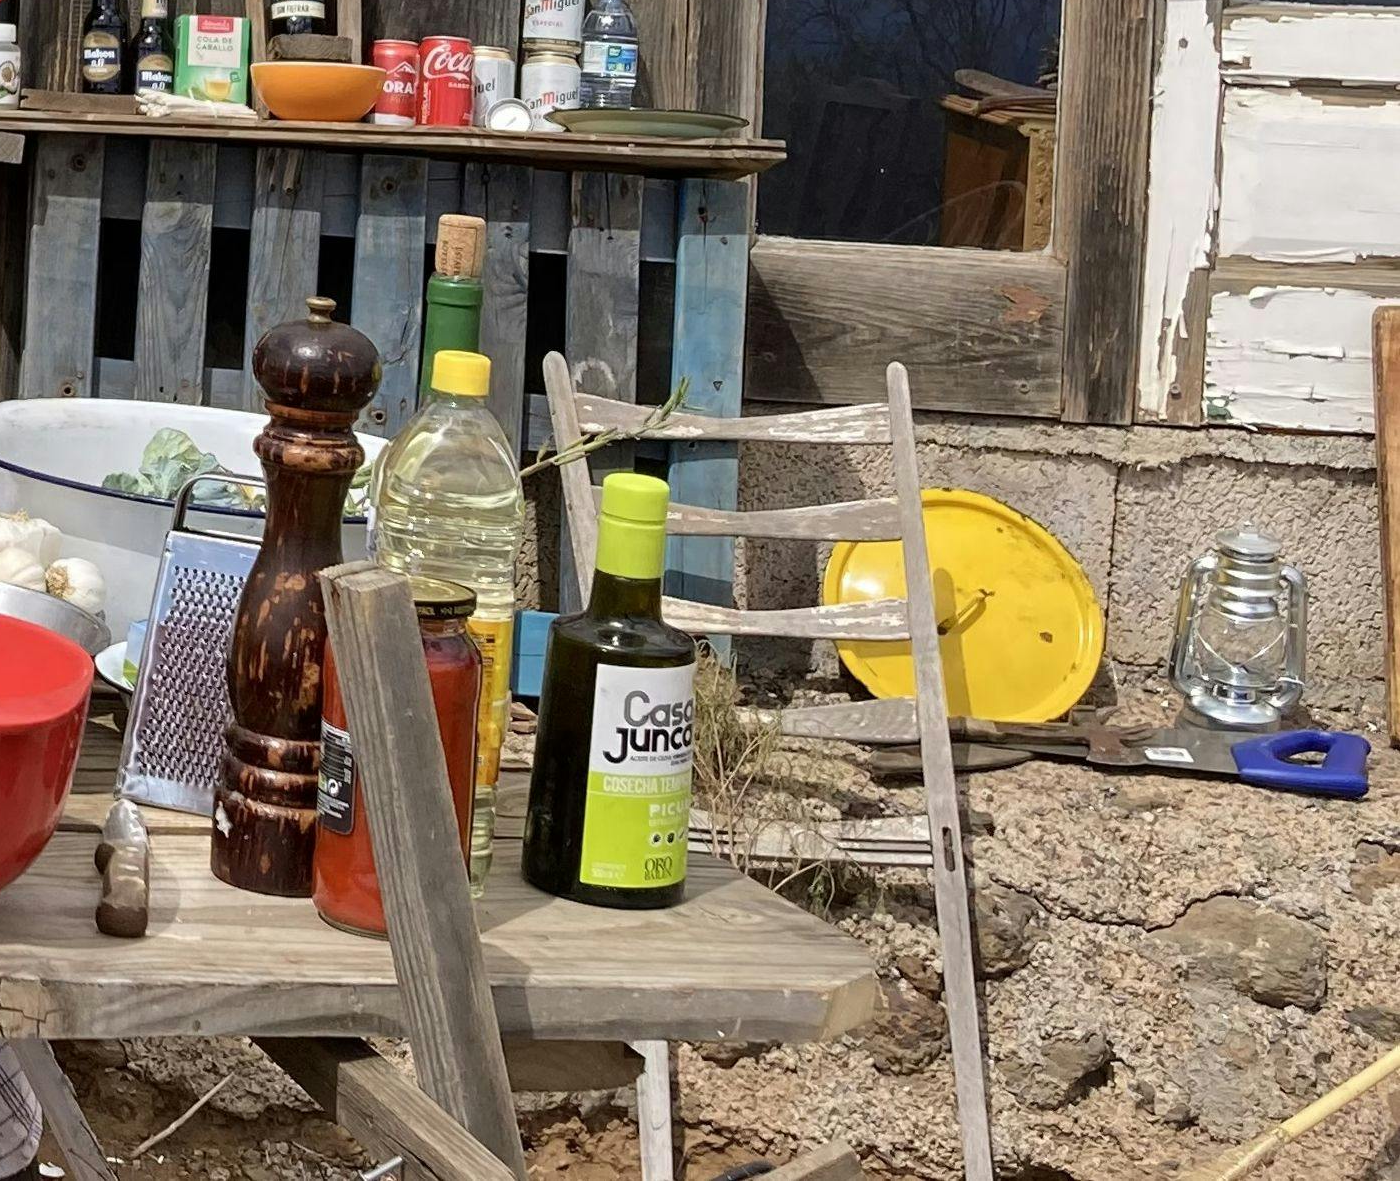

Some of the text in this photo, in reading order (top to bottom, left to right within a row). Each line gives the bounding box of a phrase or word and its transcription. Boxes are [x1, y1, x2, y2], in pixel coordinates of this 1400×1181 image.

[196, 36, 233, 45] COLA DE
[195, 43, 234, 52] CABALLO
[423, 44, 473, 79] Coca
[603, 776, 659, 794] COSECHA
